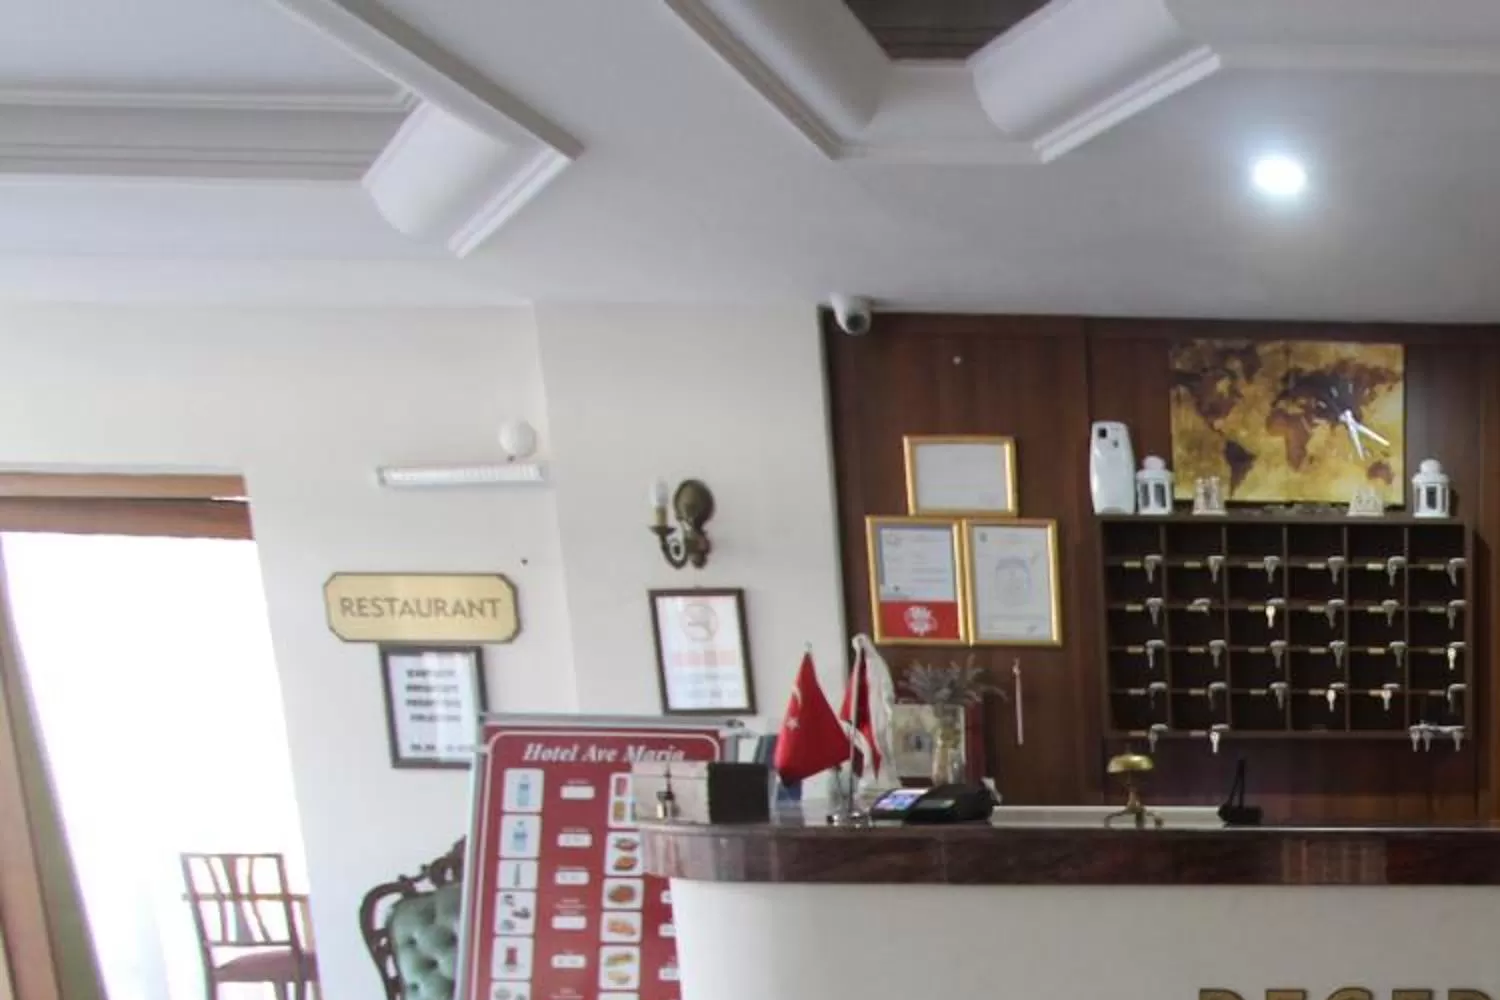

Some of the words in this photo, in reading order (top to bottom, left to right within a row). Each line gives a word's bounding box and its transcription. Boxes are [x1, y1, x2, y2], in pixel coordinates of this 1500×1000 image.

[339, 595, 502, 619] RESTAURANT
[522, 742, 580, 763] Hotel
[581, 744, 618, 763] Ave
[623, 744, 686, 763] Maria
